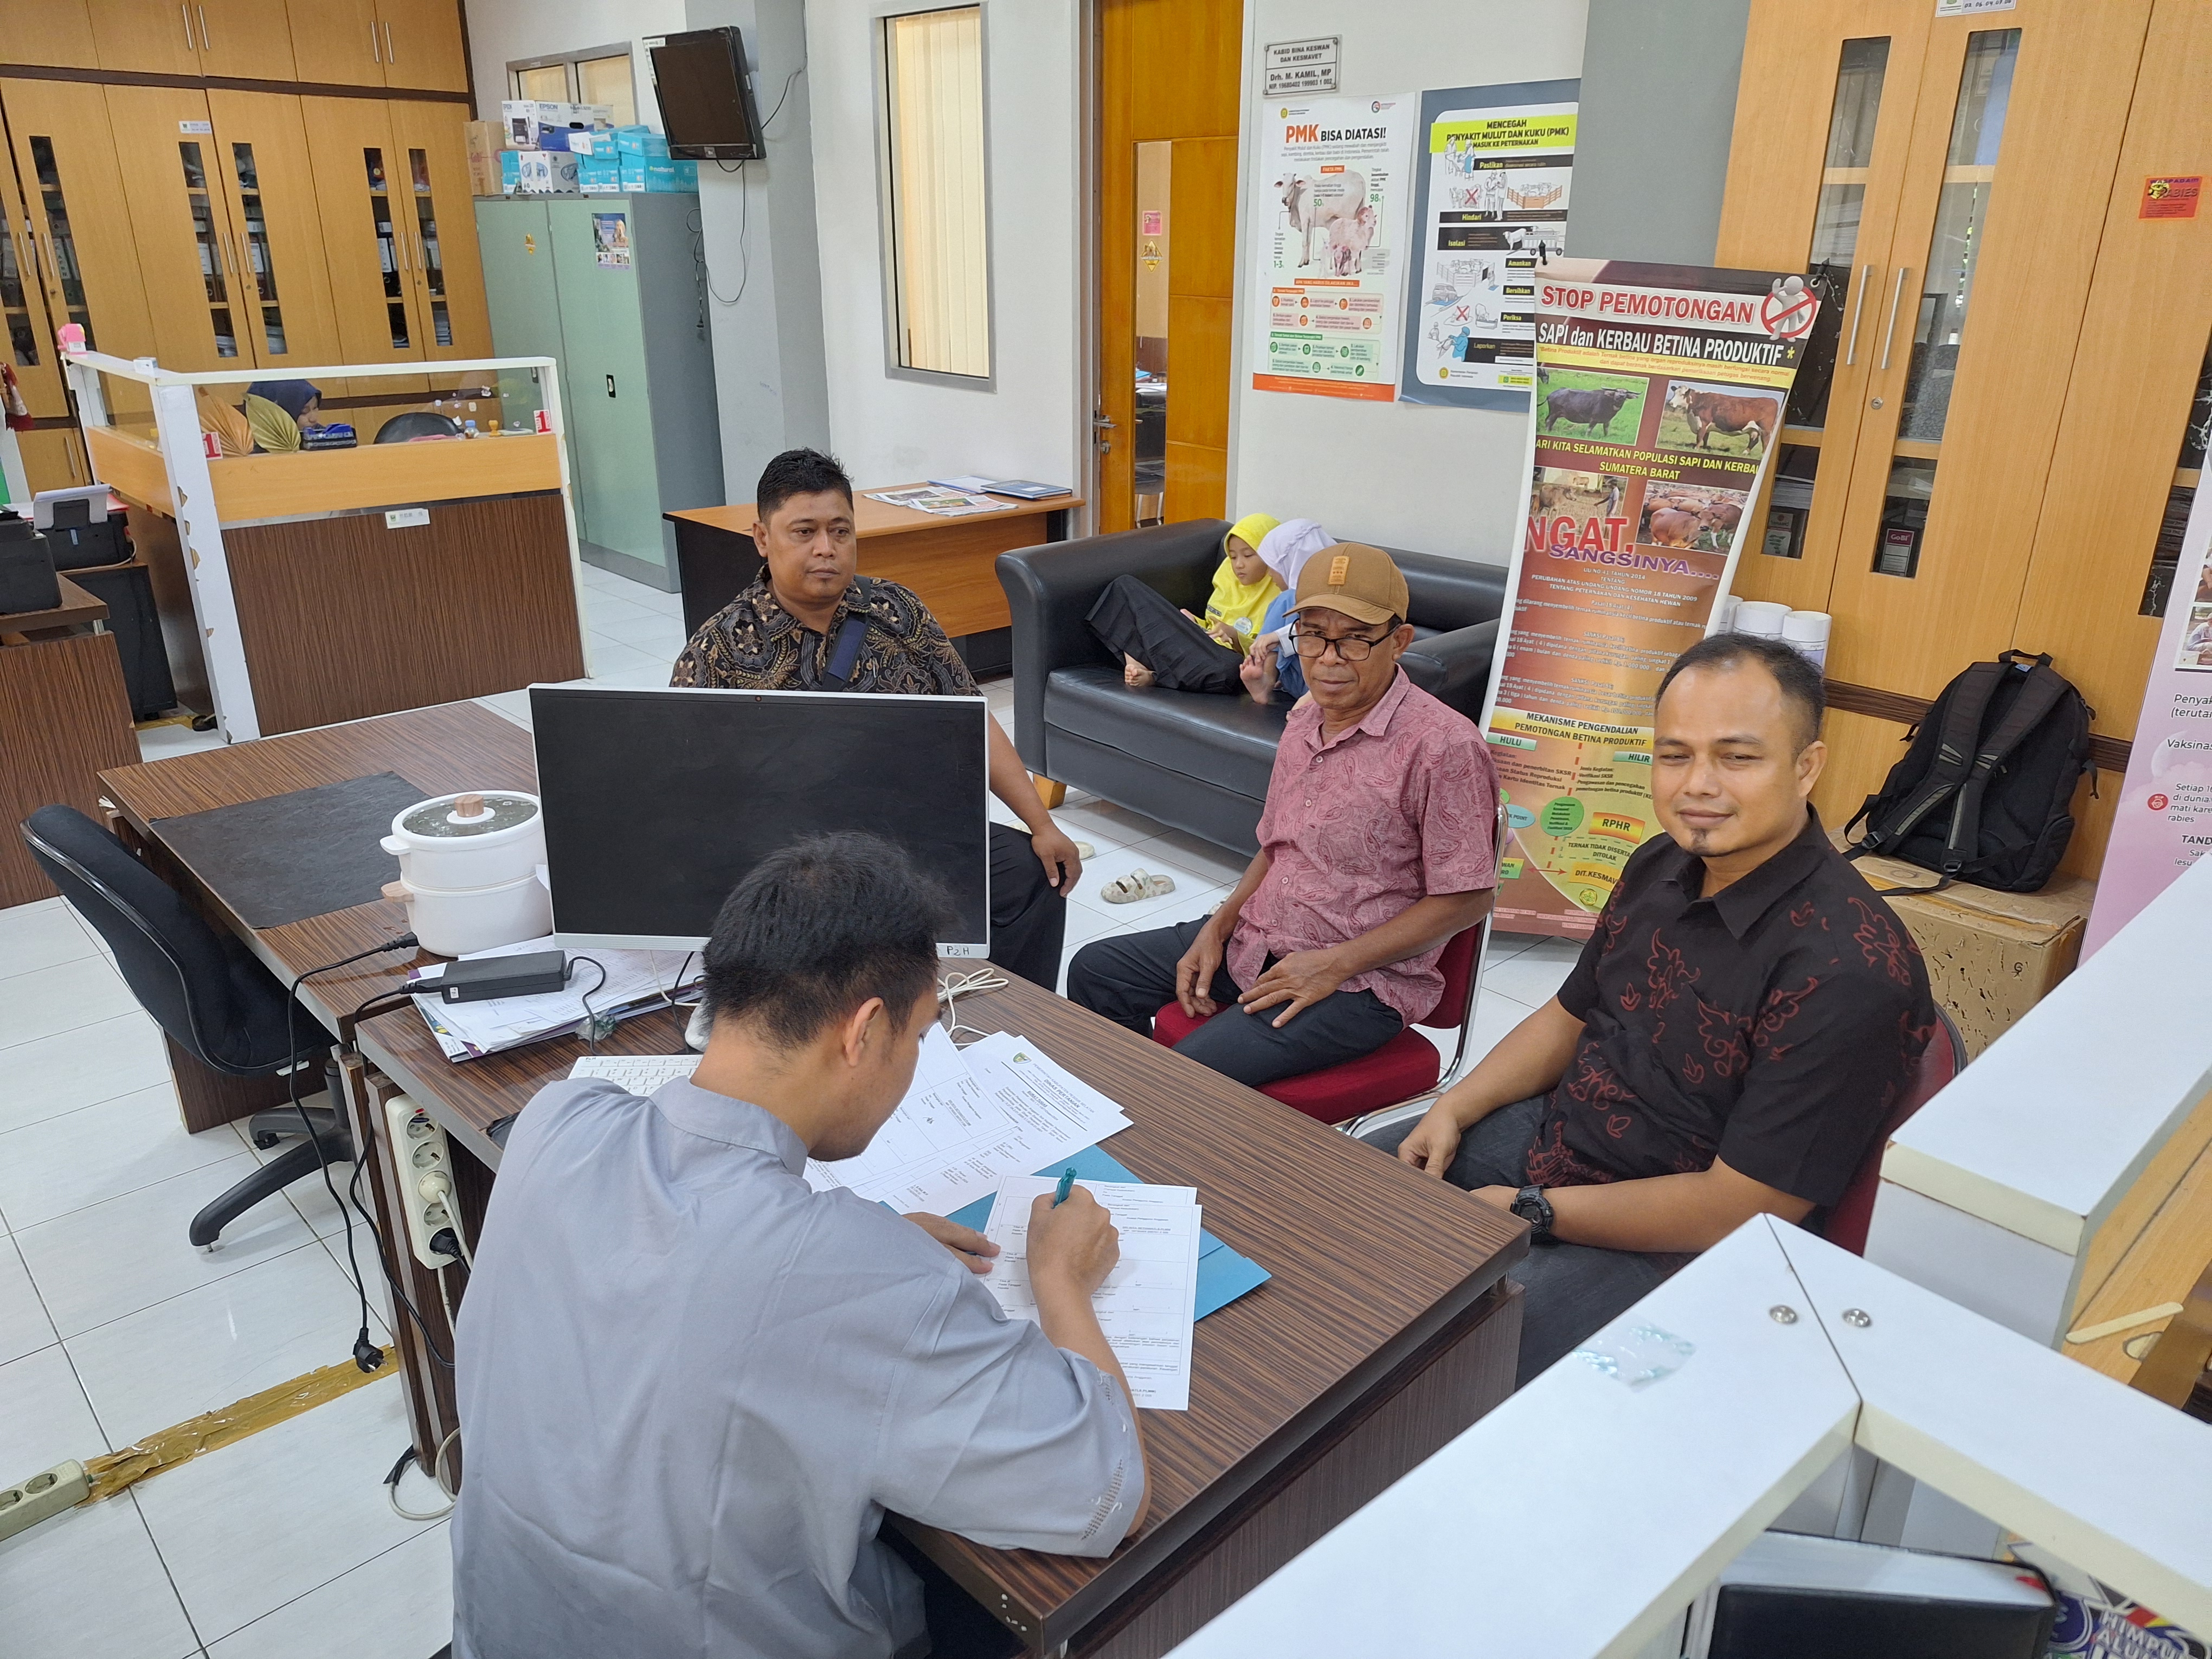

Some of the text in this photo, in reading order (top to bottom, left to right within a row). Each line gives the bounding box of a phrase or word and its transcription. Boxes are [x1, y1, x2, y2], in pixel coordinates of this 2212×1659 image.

[1487, 119, 1527, 129] MENCEGAH
[1285, 124, 1386, 143] PMK BISA DIATASI!
[1446, 127, 1569, 141] PENYAKIT MULUT DAN KUKU (PMK)
[1541, 285, 1754, 324] STOP PEMOTONGAN
[1539, 323, 1784, 365] SAPI dan KERBAU BETINA PRODUKTIF
[1667, 359, 1705, 368] reproduksinya
[1725, 364, 1750, 372] berfungsi
[1553, 441, 1571, 452] KITA
[1573, 443, 1631, 459] SELAMATKAN
[1633, 451, 1678, 465] POPULASI
[1679, 456, 1701, 467] SAPI
[1702, 459, 1722, 470] DAN
[1599, 461, 1680, 480] SUMATERA BARAT
[1532, 574, 1565, 583] PERUBAHAN
[1600, 576, 1625, 584] TENTANG
[1576, 588, 1611, 597] PETERNAKAN
[1626, 595, 1658, 603] KESEHATAN
[1523, 599, 1542, 607] dilarang
[1544, 602, 1574, 610] menyembelih
[1526, 712, 1638, 735] MEKANISME PENGENDALIAN
[1515, 723, 1647, 747] PEMOTONGAN BETINA PRODUKTIF
[1500, 736, 1522, 746] HULU
[1628, 754, 1650, 763] HILIR
[1523, 764, 1554, 773] penerbitan
[1510, 768, 1562, 782] Status Reproduksi
[1520, 777, 1545, 787] Identitas
[1615, 782, 1645, 790] pencegahan
[1620, 789, 1643, 797] produktif
[2176, 783, 2204, 793] Setiap
[2168, 814, 2195, 822] rabies
[1602, 818, 1631, 832] RPHR
[1593, 852, 1617, 861] DITOLAK
[2175, 858, 2193, 866] lesu
